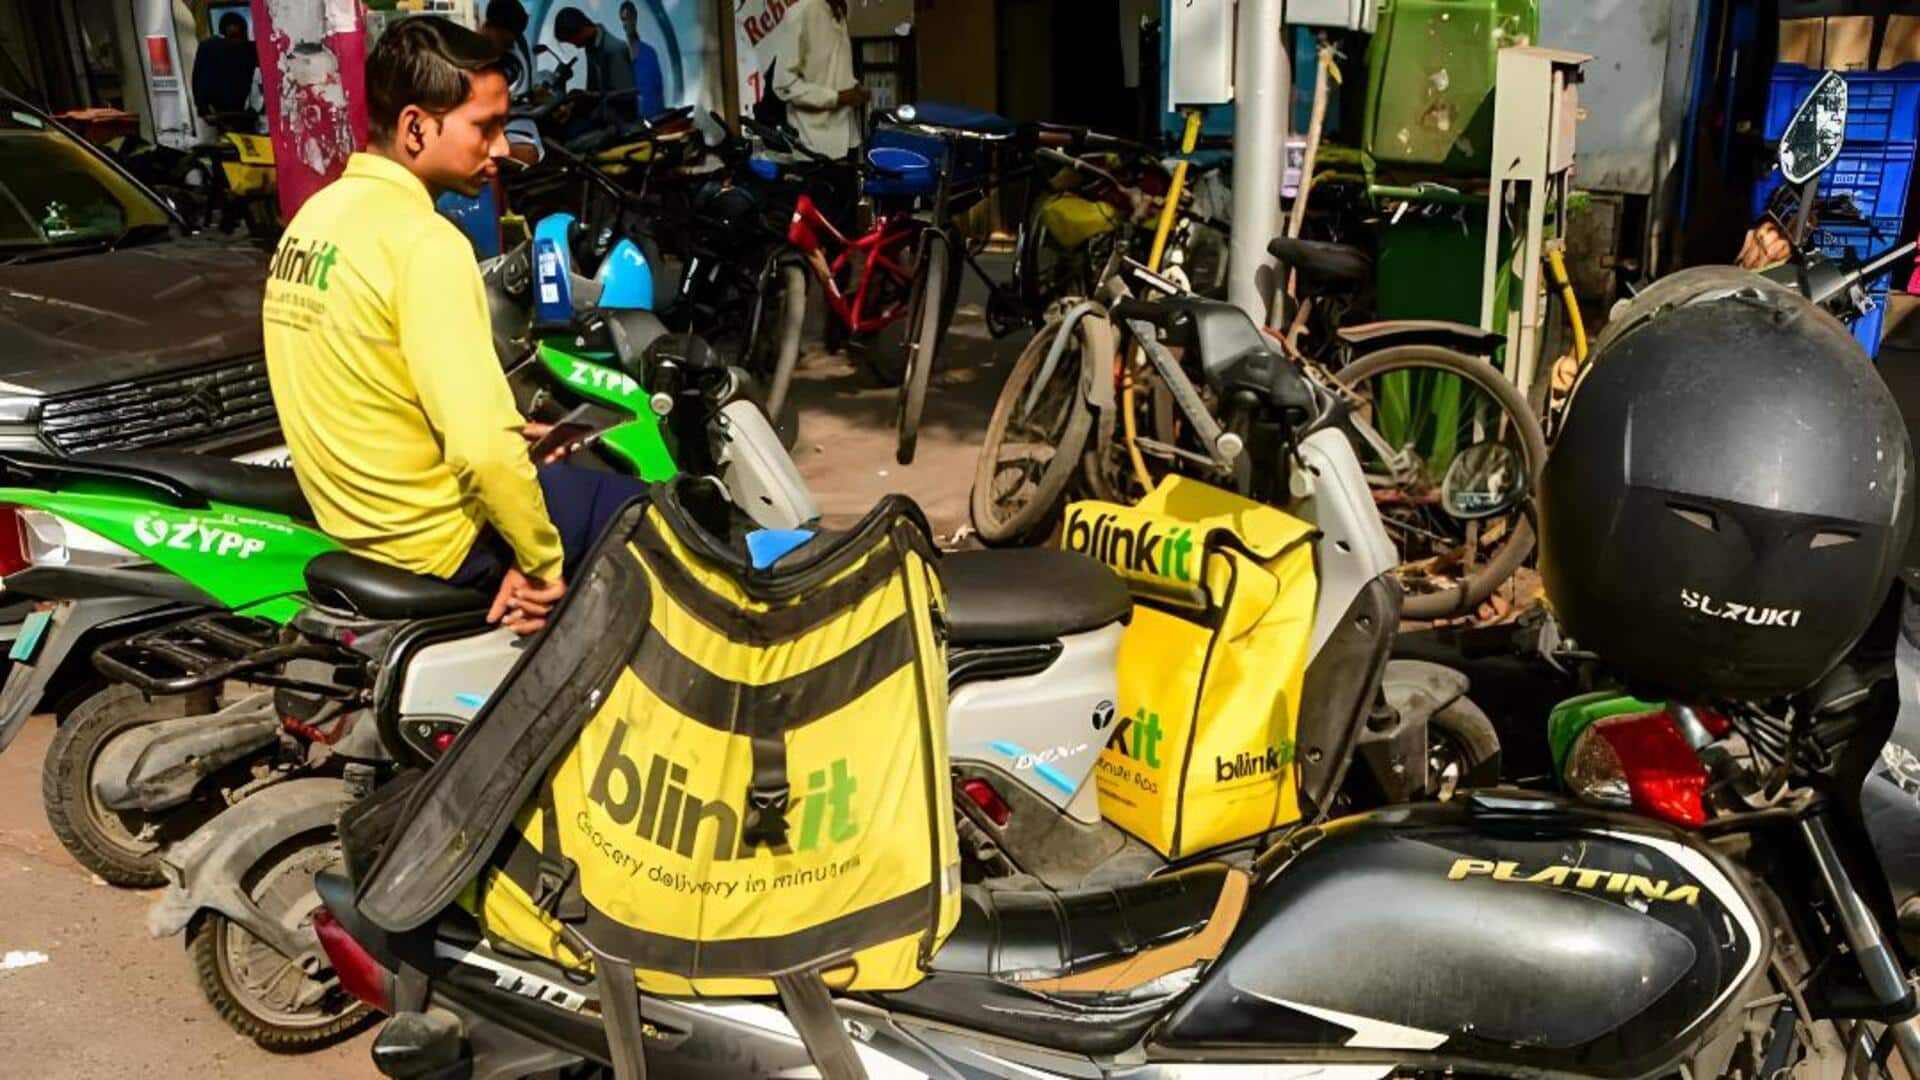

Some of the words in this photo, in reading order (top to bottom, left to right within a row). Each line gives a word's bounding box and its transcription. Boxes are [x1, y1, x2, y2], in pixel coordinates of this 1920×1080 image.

[567, 360, 639, 396] ZYPP
[167, 516, 266, 559] ZYPP
[1066, 508, 1193, 581] blinkit
[1680, 588, 1801, 628] SUZUKI
[648, 865, 738, 898] delivery
[745, 873, 766, 893] in
[1448, 859, 1701, 906] PLATINA
